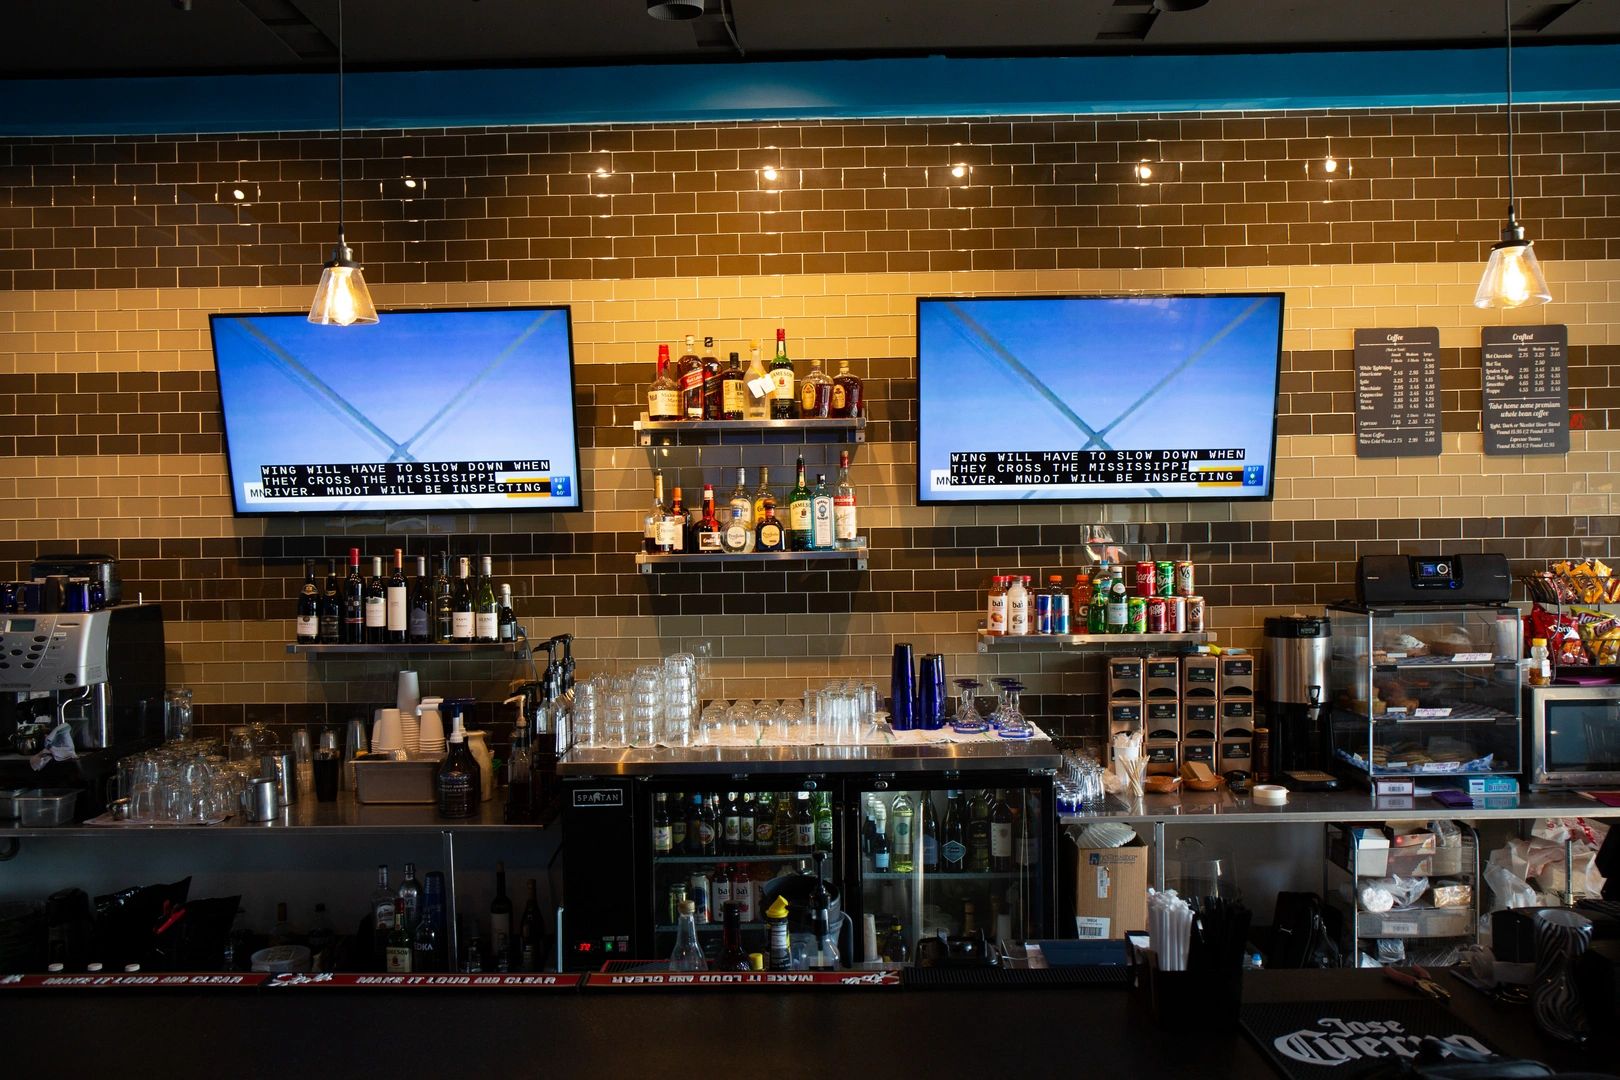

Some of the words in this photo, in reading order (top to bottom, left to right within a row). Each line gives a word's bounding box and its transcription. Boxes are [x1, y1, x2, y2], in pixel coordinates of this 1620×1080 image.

[1386, 333, 1404, 343] Coffee
[1512, 333, 1534, 342] Crafted
[1488, 402, 1502, 410] Take
[1534, 402, 1561, 410] premium
[1532, 410, 1550, 419] coffee
[951, 453, 987, 463] WING
[997, 453, 1033, 462] WILL
[1043, 452, 1079, 461] HAVE
[1090, 451, 1106, 461] TO
[1117, 451, 1153, 460] SLOW
[1162, 451, 1198, 460] DOWN
[1209, 450, 1244, 459] WHEN
[262, 465, 297, 475] WING
[307, 465, 341, 474] WILL
[351, 464, 386, 474] HAVE
[396, 463, 413, 473] TO
[423, 462, 458, 472] SLOW
[468, 462, 503, 471] DOWN
[513, 461, 549, 471] WHEN
[951, 464, 987, 473] THEY
[997, 463, 1042, 473] CROSS
[1052, 463, 1078, 472] THE
[1089, 461, 1188, 472] MISSISSIPPI
[263, 477, 298, 486] THEY
[307, 476, 351, 485] CROSS
[361, 475, 387, 484] THE
[397, 473, 495, 484] MISSISSIPPI
[951, 475, 1004, 485] RIVER.
[1015, 474, 1060, 484] MNDOT
[1070, 474, 1105, 483] WILL
[1116, 473, 1133, 482] BE
[1144, 472, 1233, 482] INSPECTING
[264, 487, 316, 497] RIVER.
[326, 486, 370, 495] MNDOT
[380, 485, 415, 494] WILL
[425, 484, 442, 493] BE
[452, 483, 541, 493] INSPECTING
[992, 599, 1004, 607] bai
[1012, 600, 1024, 610] bai
[41, 976, 94, 985] MAKE
[92, 976, 114, 984] IT
[112, 976, 159, 984] LOUD
[159, 976, 189, 984] AND
[189, 976, 244, 984] CLEAR
[356, 976, 405, 984] MAKE
[406, 976, 425, 984] IT
[425, 976, 471, 984] LOUD
[473, 976, 501, 984] AND
[503, 976, 557, 984] CLEAR
[611, 975, 664, 984] CLEAR
[668, 975, 695, 983] AND
[698, 974, 743, 982] LOUD
[746, 974, 762, 982] IT
[766, 974, 814, 982] MAKE
[1317, 1017, 1405, 1039] Jose
[1273, 1028, 1494, 1067] Cuero
